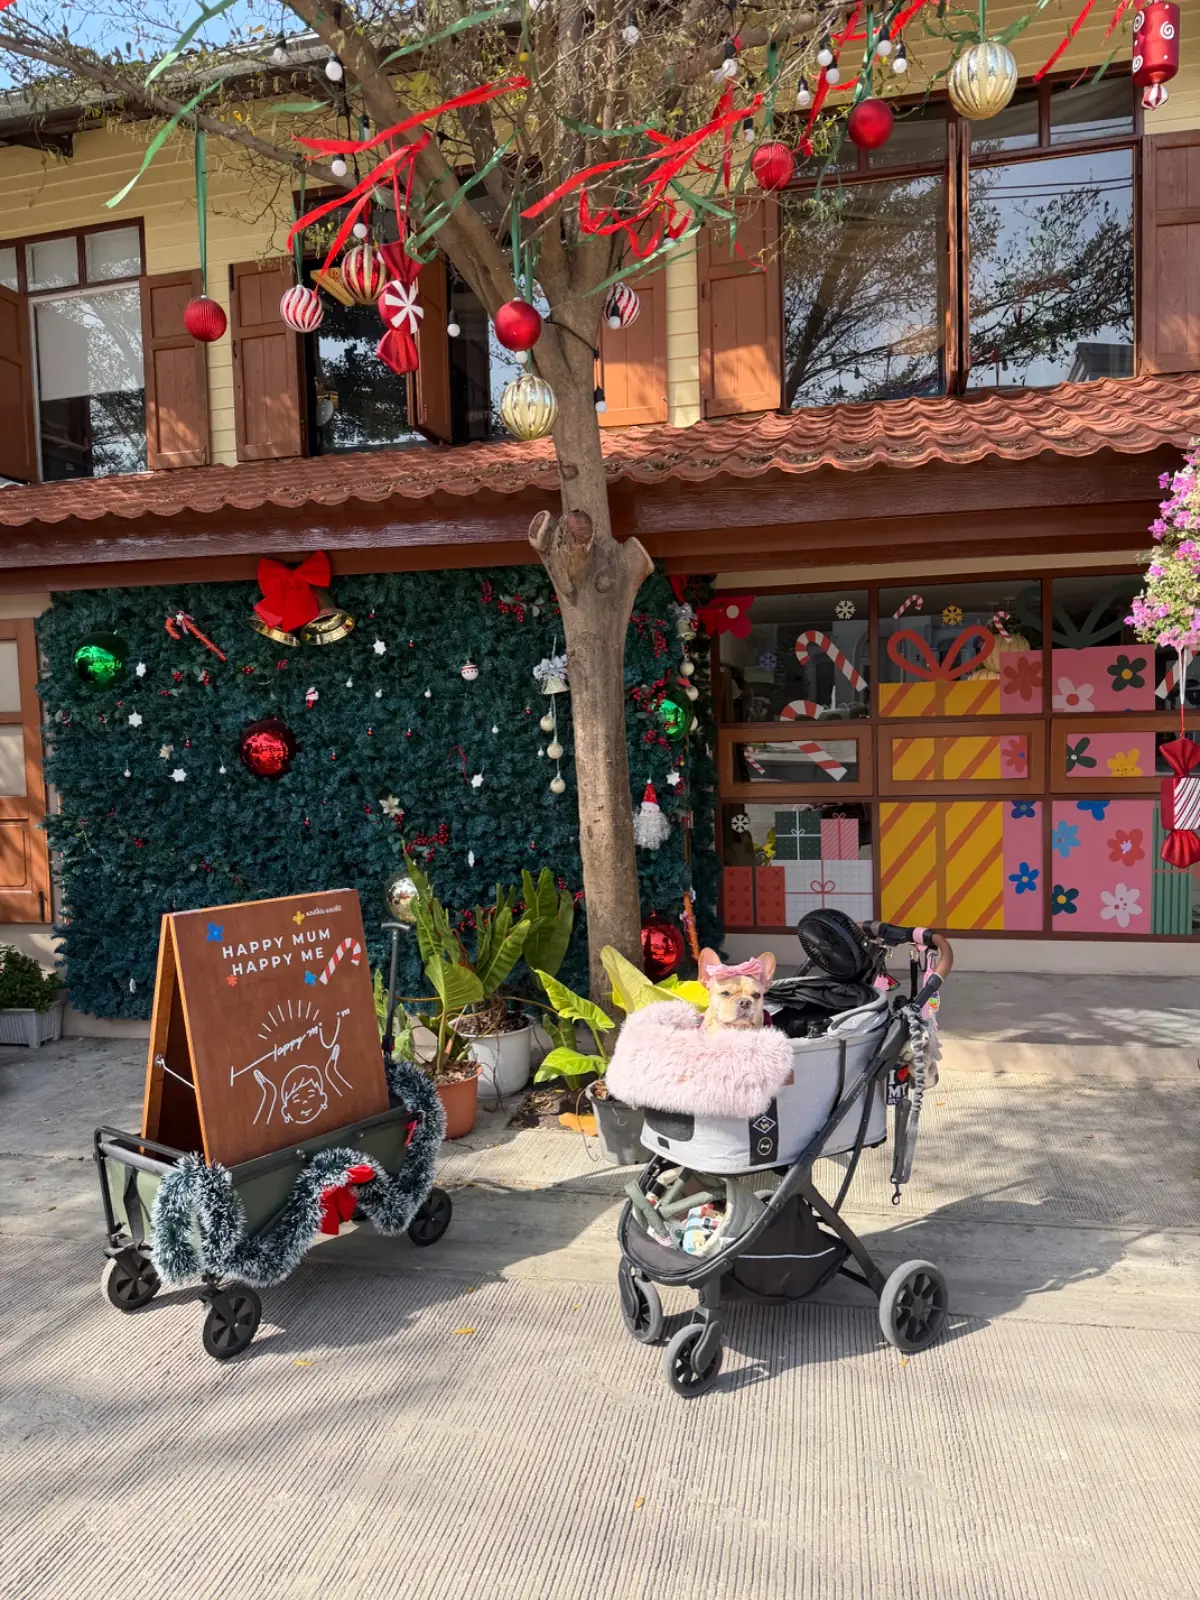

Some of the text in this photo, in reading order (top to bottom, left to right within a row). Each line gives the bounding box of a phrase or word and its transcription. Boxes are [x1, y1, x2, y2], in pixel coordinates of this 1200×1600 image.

[222, 928, 330, 959] HAPPY MUM
[232, 947, 324, 976] HAPPY ME
[888, 1069, 896, 1084] I
[888, 1083, 908, 1098] MY
